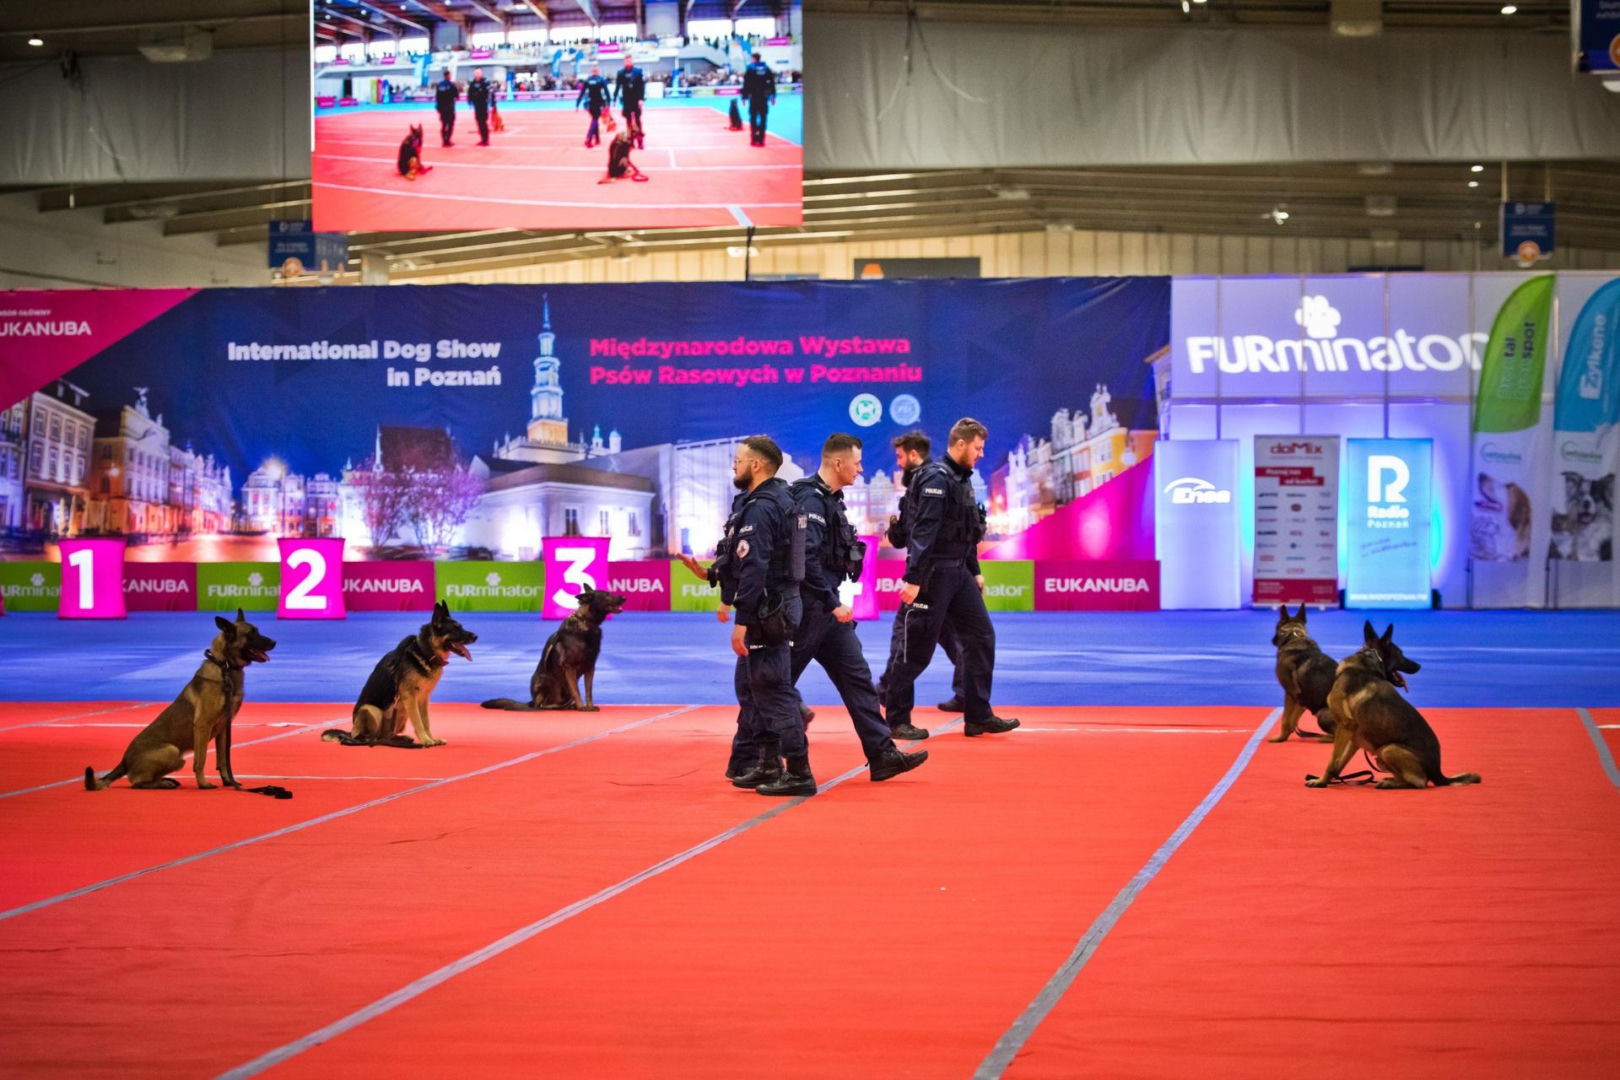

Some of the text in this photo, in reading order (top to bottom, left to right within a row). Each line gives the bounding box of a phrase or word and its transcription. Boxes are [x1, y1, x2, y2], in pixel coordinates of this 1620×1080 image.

[228, 339, 501, 362] International Dog Show
[590, 336, 911, 359] Międzynarodowa Wystawa
[1186, 328, 1490, 373] FURminator
[387, 365, 501, 387] in Poznań
[590, 362, 922, 387] Psów Rasowych w Poznaniu
[1367, 505, 1410, 518] Radio
[68, 549, 94, 609] 1
[285, 548, 327, 609] 2
[342, 579, 423, 593] UKANUBA
[552, 547, 597, 610] 3
[1044, 578, 1149, 592] EUKANUBA
[207, 584, 281, 597] FURmina
[446, 584, 538, 597] FURminator
